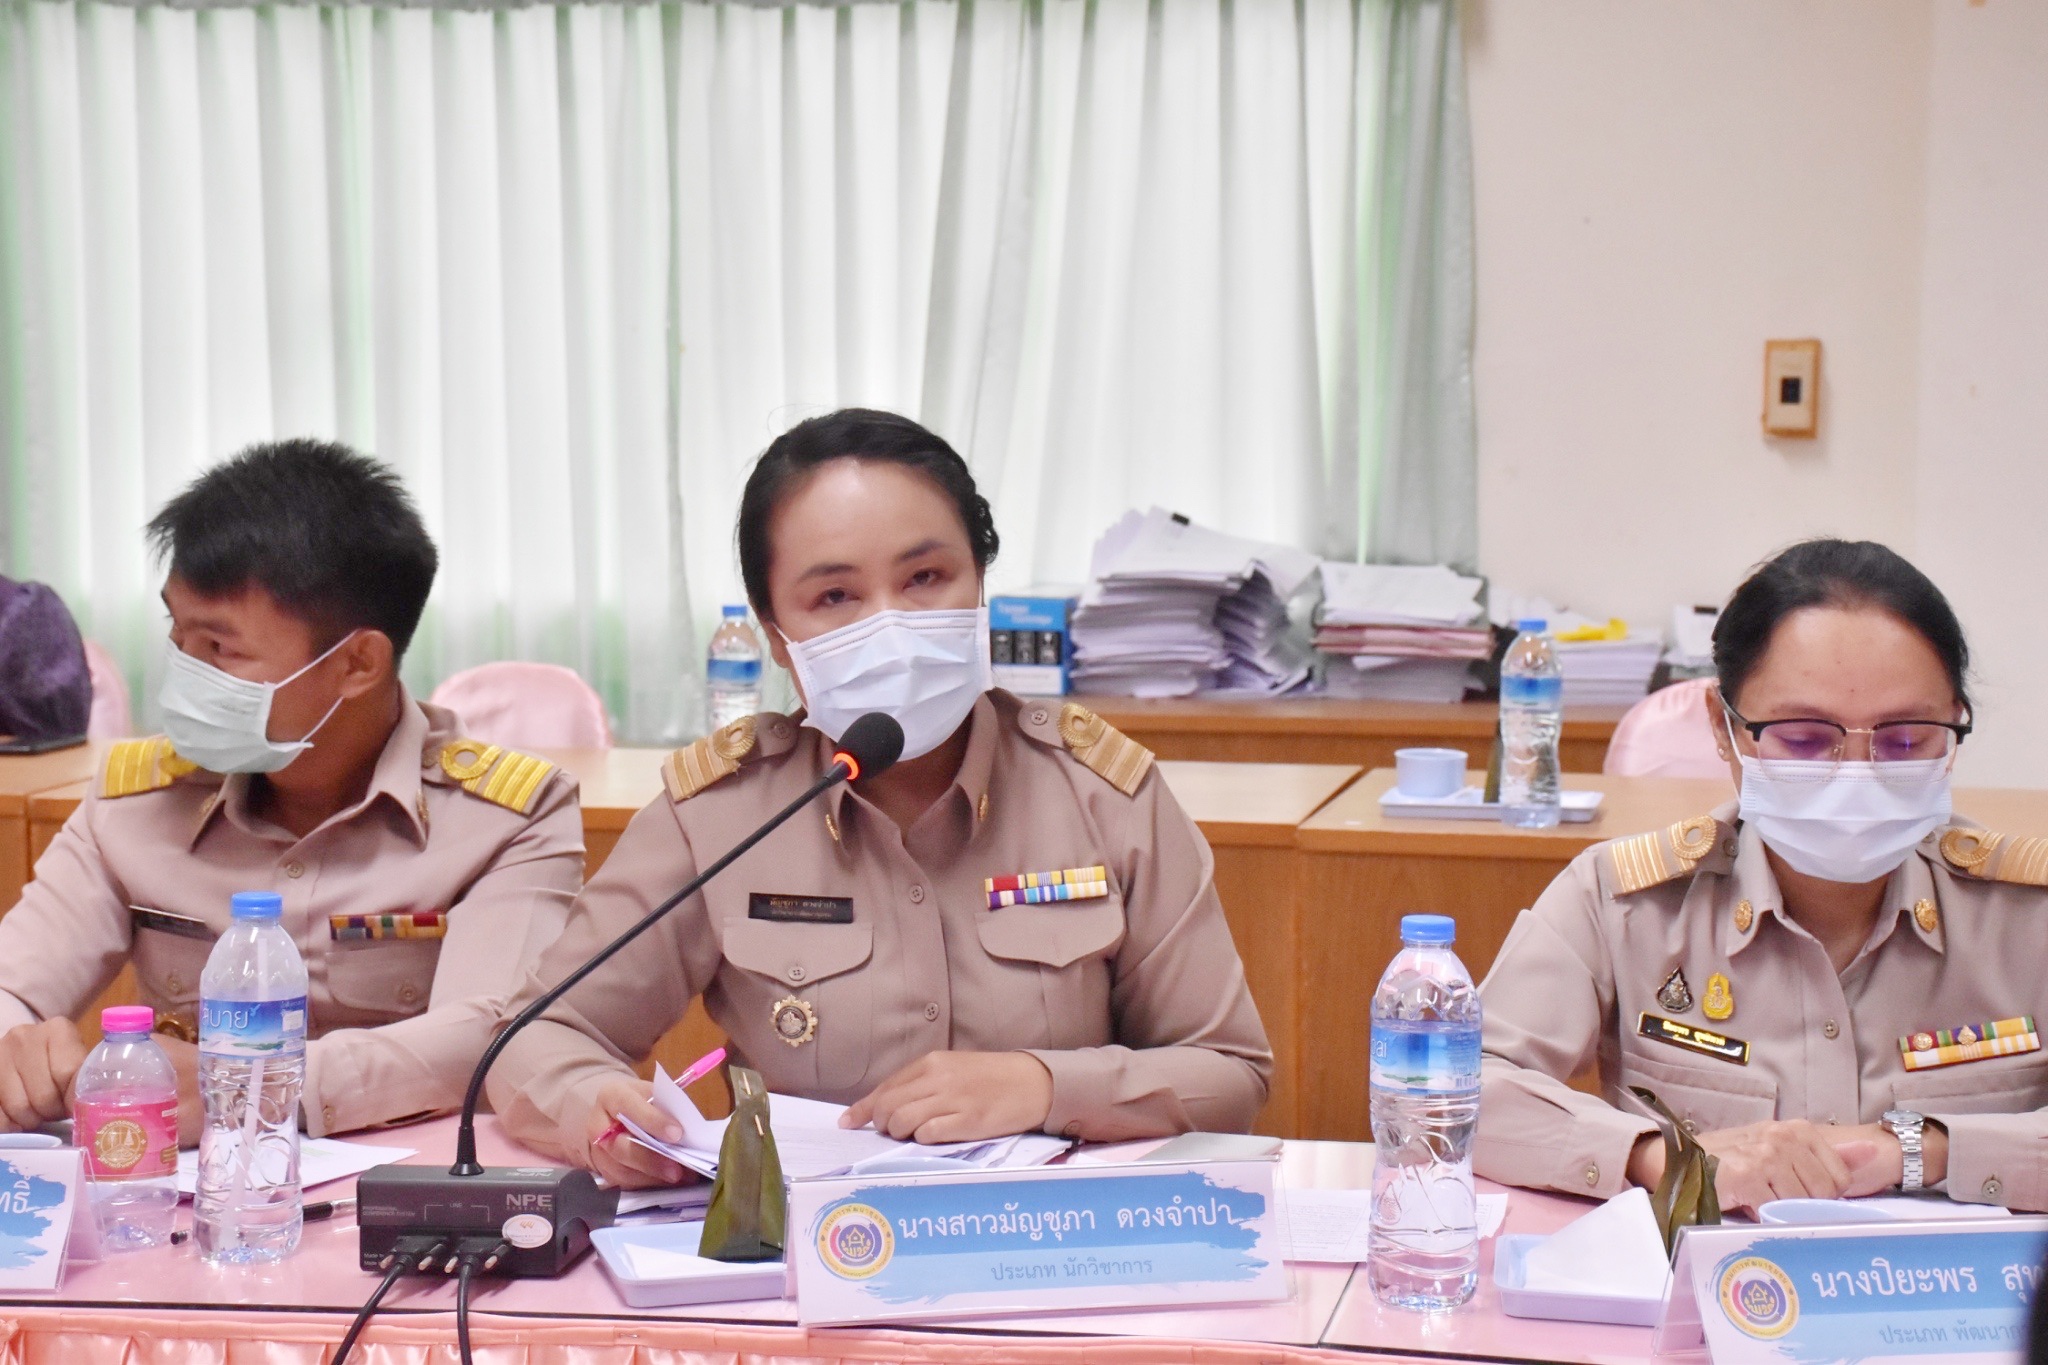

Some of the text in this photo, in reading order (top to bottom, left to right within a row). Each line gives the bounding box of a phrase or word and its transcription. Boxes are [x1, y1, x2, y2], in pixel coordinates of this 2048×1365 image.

[506, 1193, 552, 1207] NPE
[898, 1202, 1096, 1241] นางสาวมัญชุภา
[1117, 1195, 1235, 1229] ดวงจำปา
[991, 1257, 1153, 1281] ประเภท นักวิชาการ
[1811, 1257, 1978, 1298] นางปิยะพร
[1879, 1325, 1948, 1344] ประเภท
